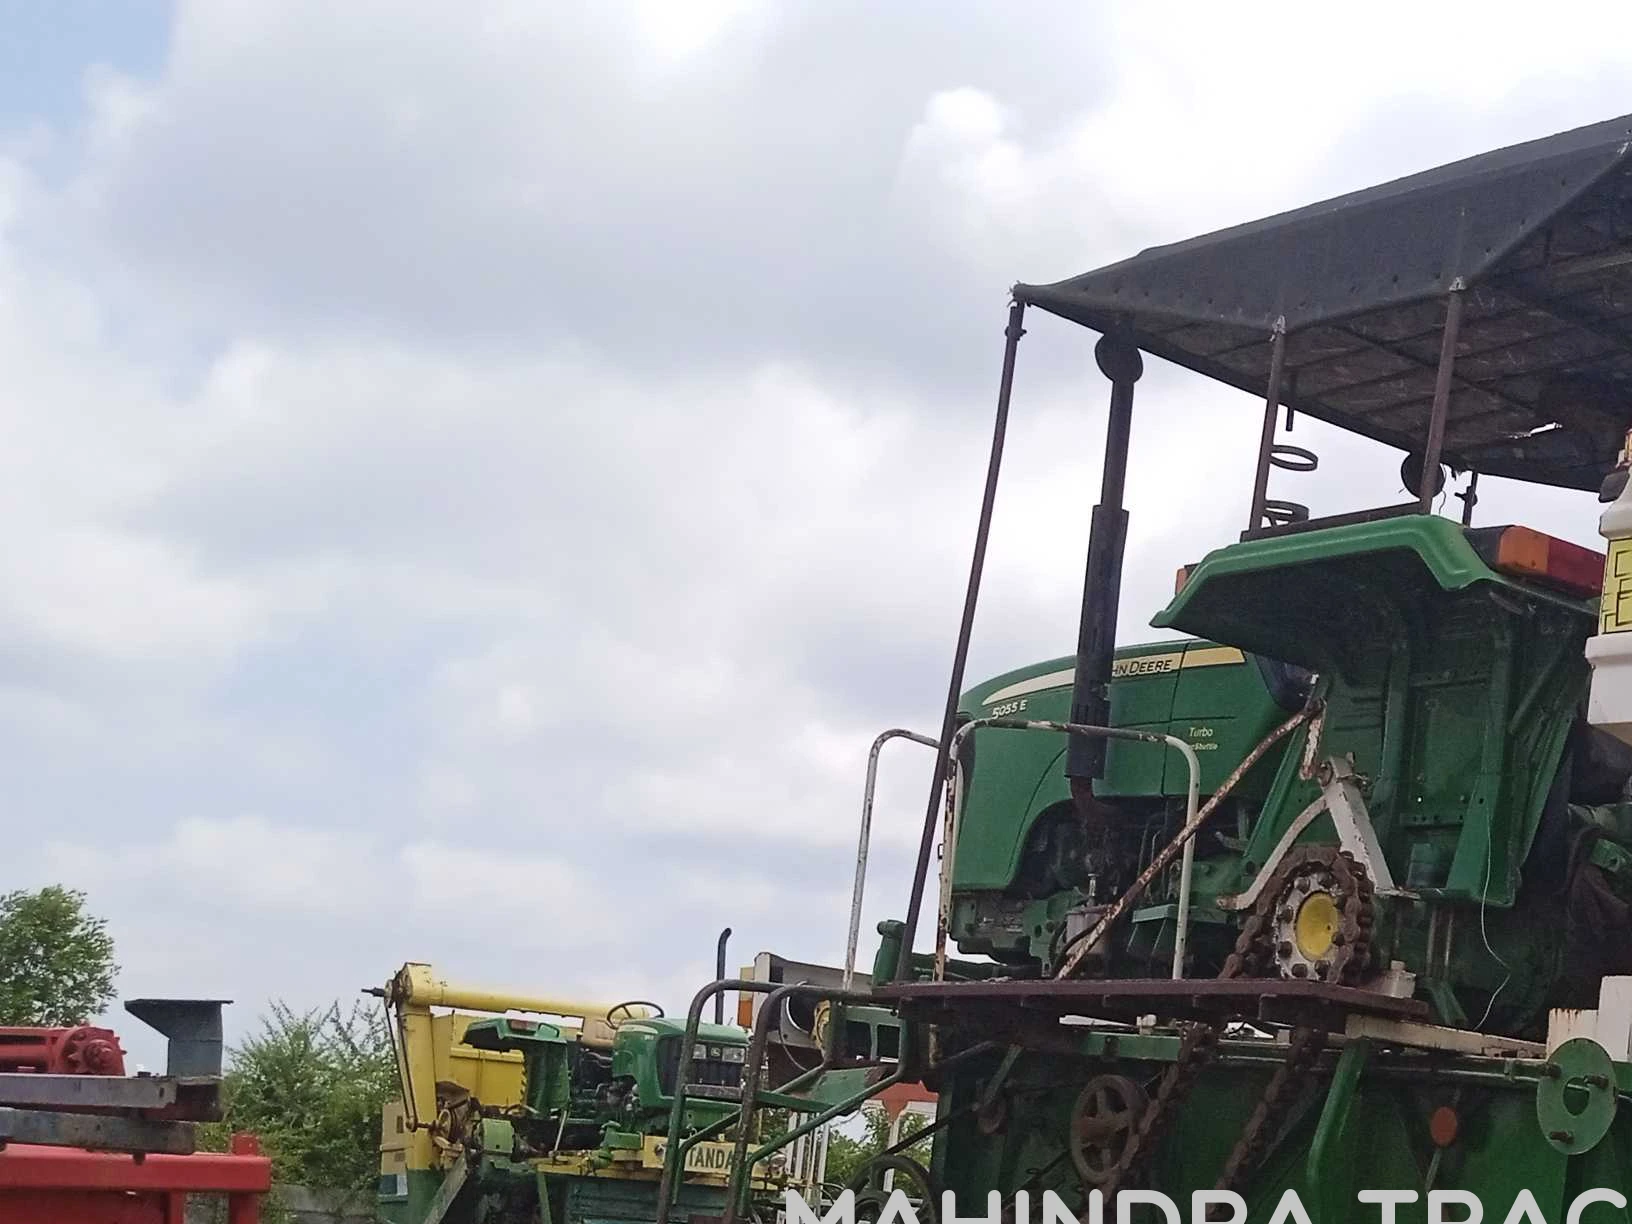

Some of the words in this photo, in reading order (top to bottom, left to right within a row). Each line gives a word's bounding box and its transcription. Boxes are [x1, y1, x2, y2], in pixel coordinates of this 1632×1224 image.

[1129, 659, 1172, 674] DEERE
[991, 701, 1018, 720] 5055
[1018, 699, 1029, 712] E
[1189, 726, 1213, 737] Turbo
